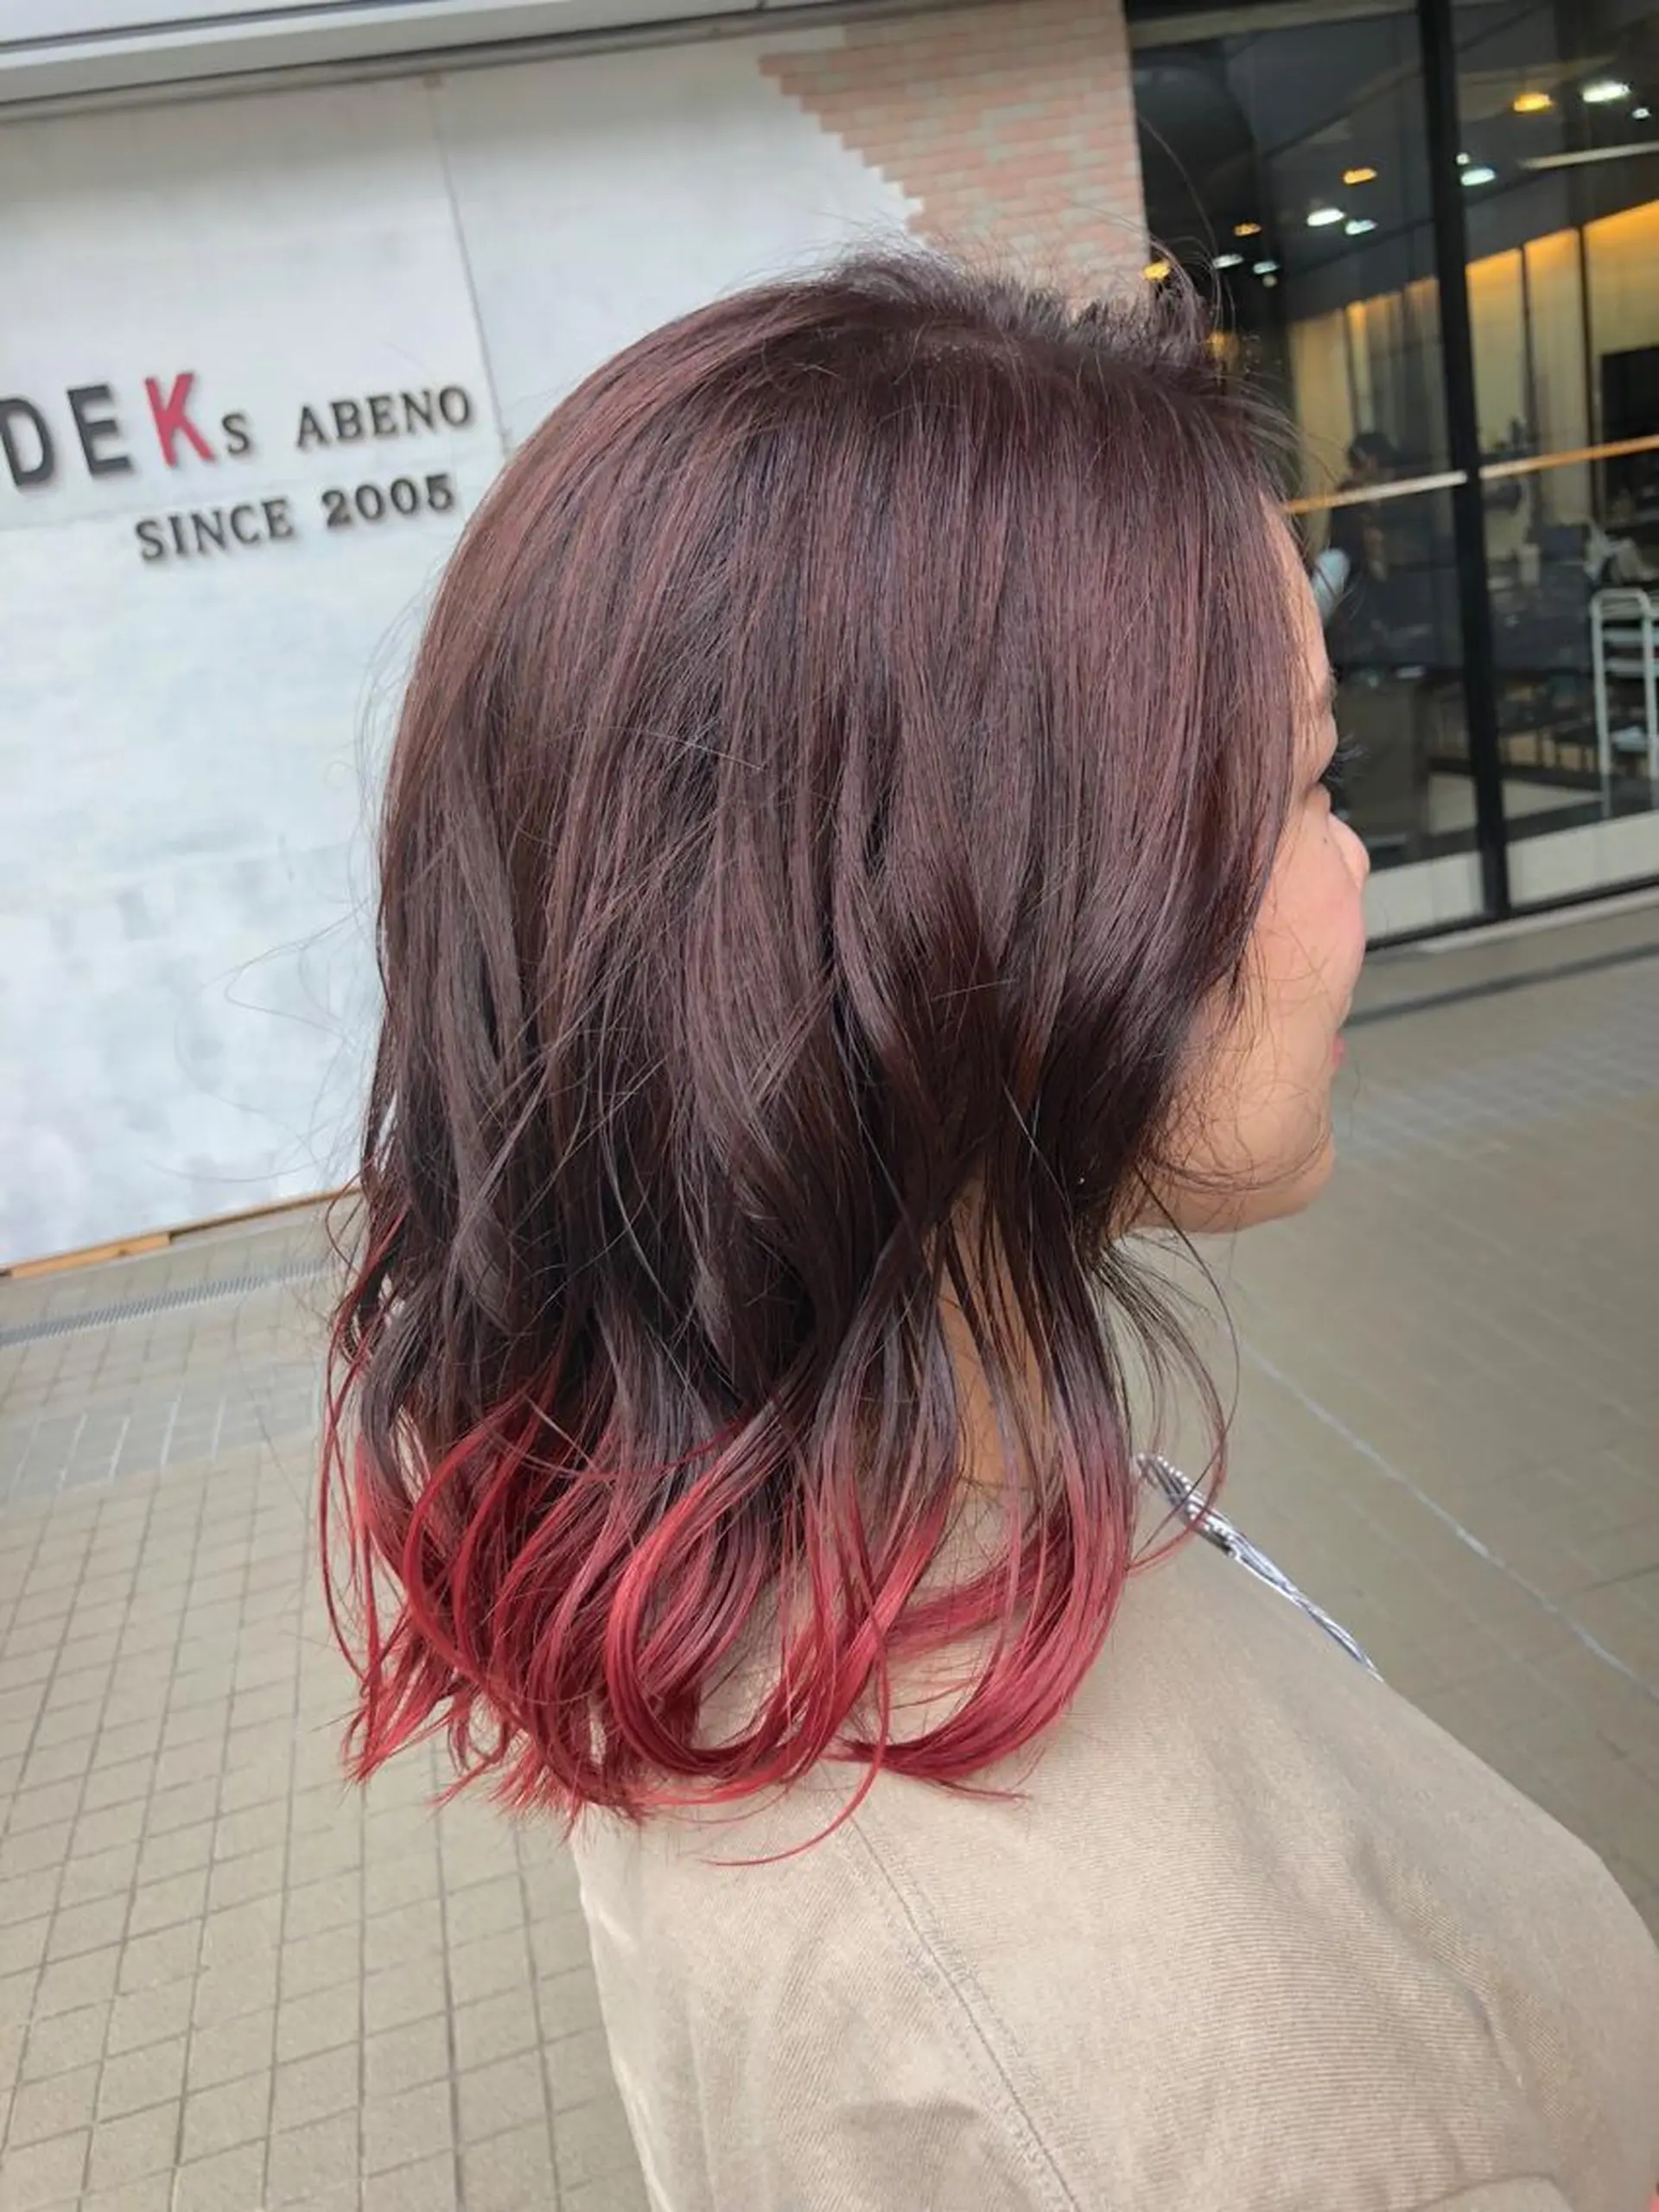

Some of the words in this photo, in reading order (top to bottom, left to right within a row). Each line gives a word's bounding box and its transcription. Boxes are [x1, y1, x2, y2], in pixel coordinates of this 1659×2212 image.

[296, 385, 472, 449] ABENO
[135, 498, 294, 562] SINCE
[322, 473, 454, 529] 2005
